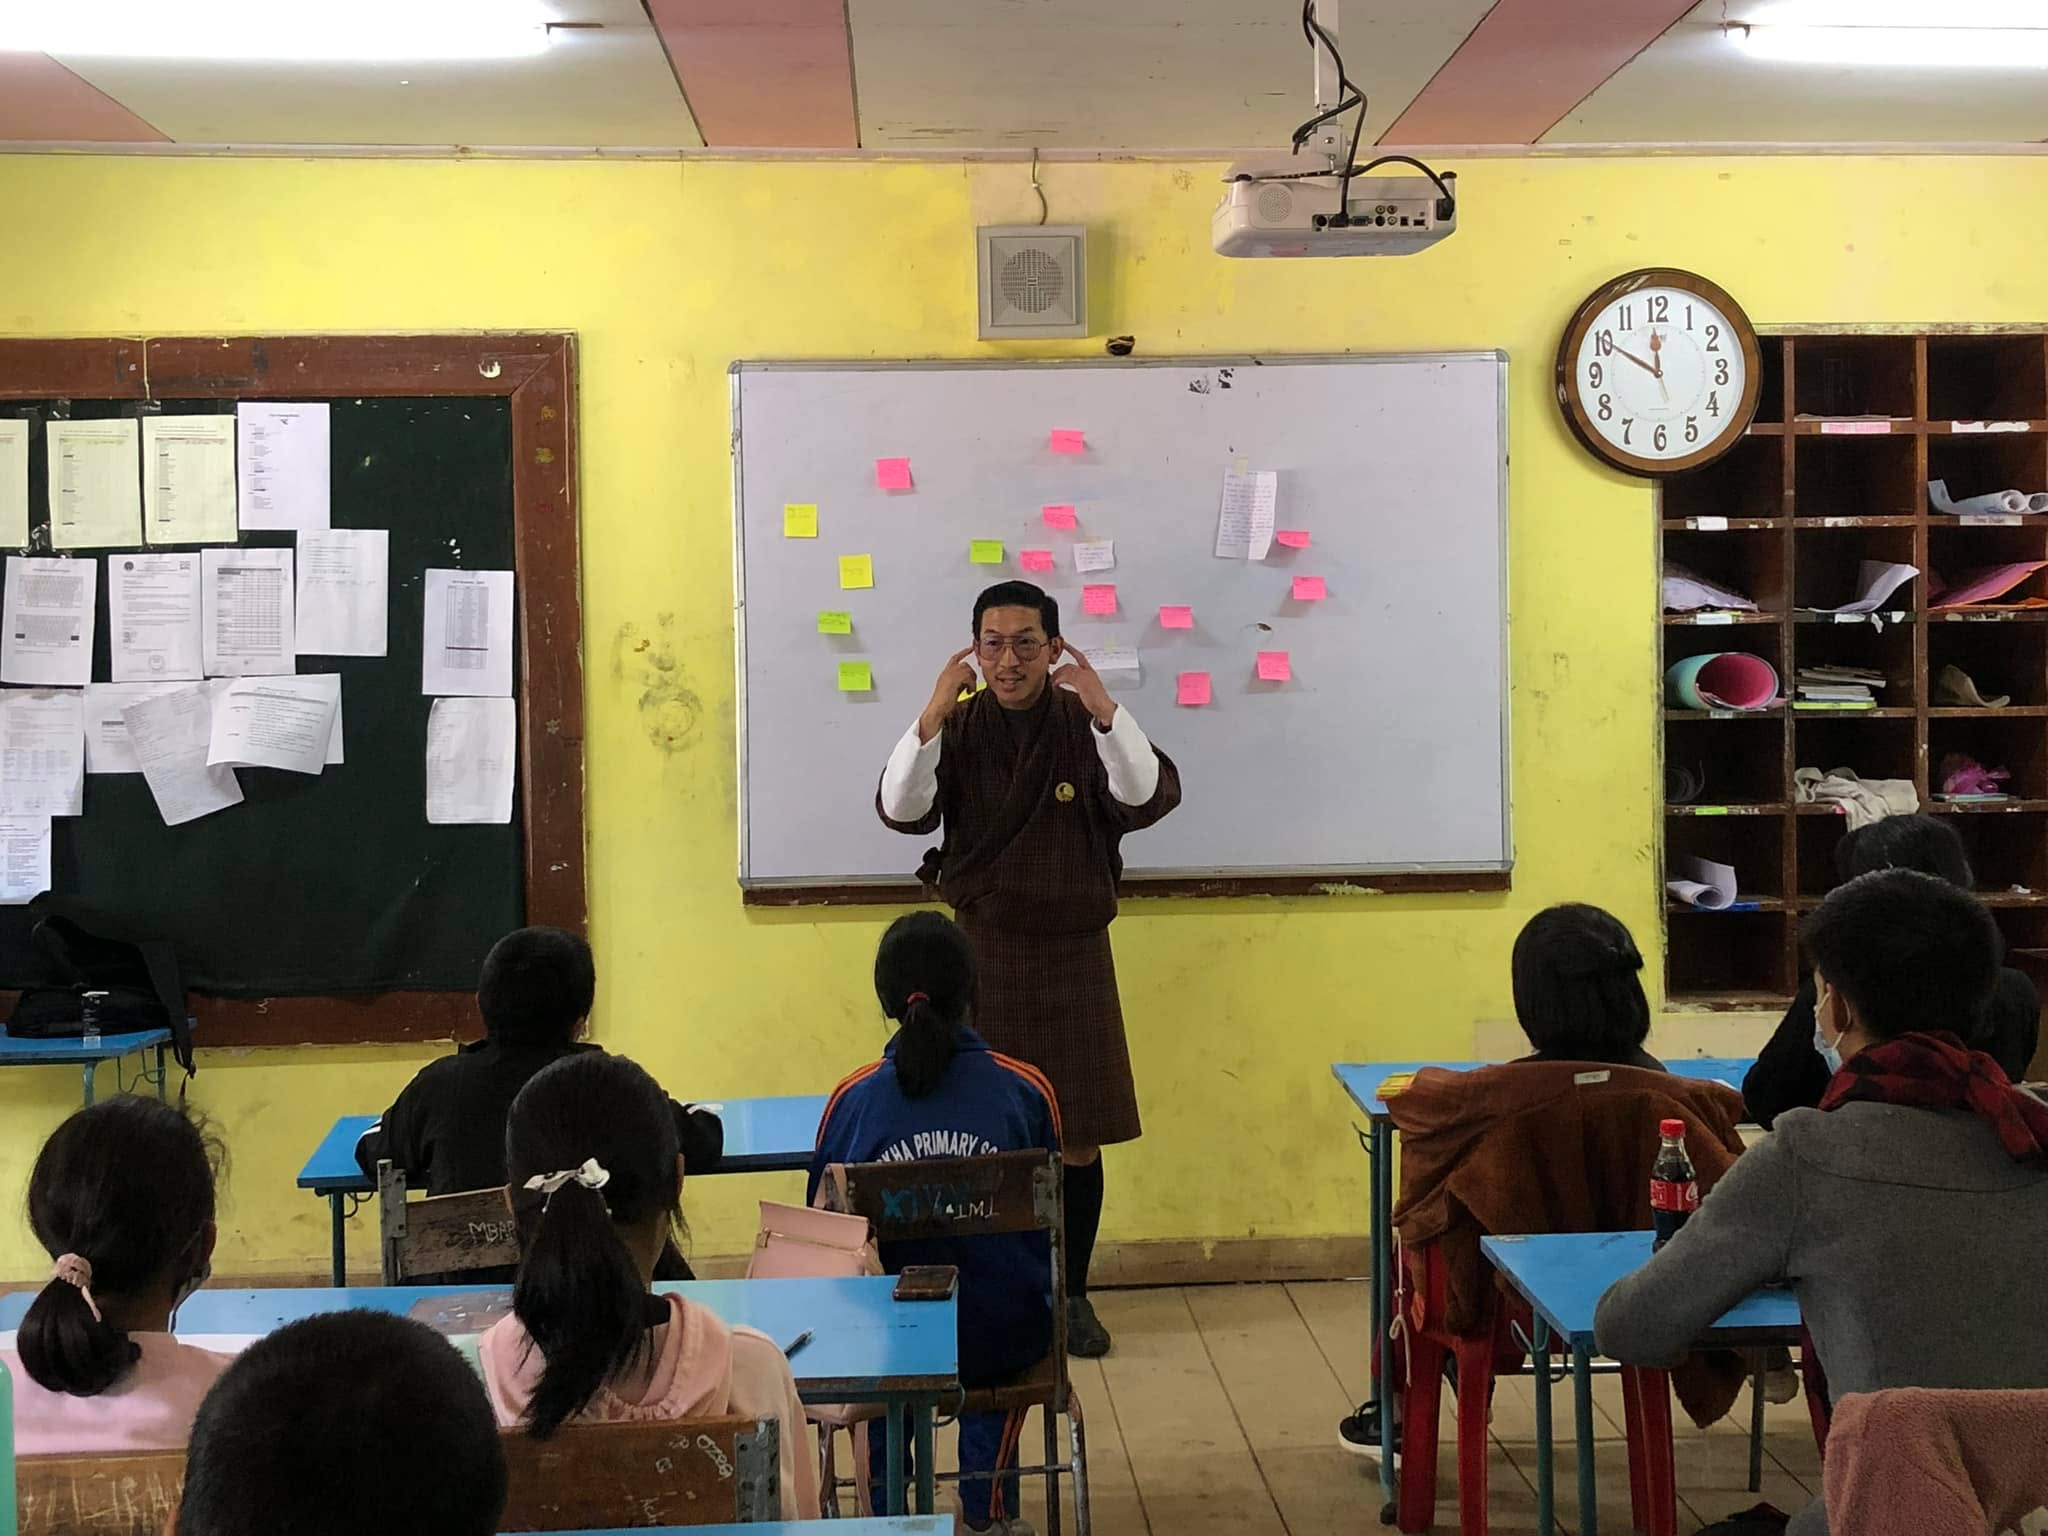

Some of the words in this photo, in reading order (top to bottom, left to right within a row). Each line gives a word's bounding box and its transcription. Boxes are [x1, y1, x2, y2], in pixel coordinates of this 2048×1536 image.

[1619, 304, 1632, 330] 11
[1646, 295, 1668, 322] 12
[1685, 304, 1693, 330] 1
[1594, 329, 1612, 355] 10
[1705, 325, 1719, 351] 2
[1588, 361, 1602, 388] 9
[1714, 358, 1728, 385] 3
[1598, 393, 1612, 420] 8
[1705, 391, 1719, 416] 4
[1621, 418, 1633, 444] 7
[1653, 424, 1666, 450] 6
[1684, 415, 1698, 441] 5
[913, 1130, 979, 1158] PRIMARY
